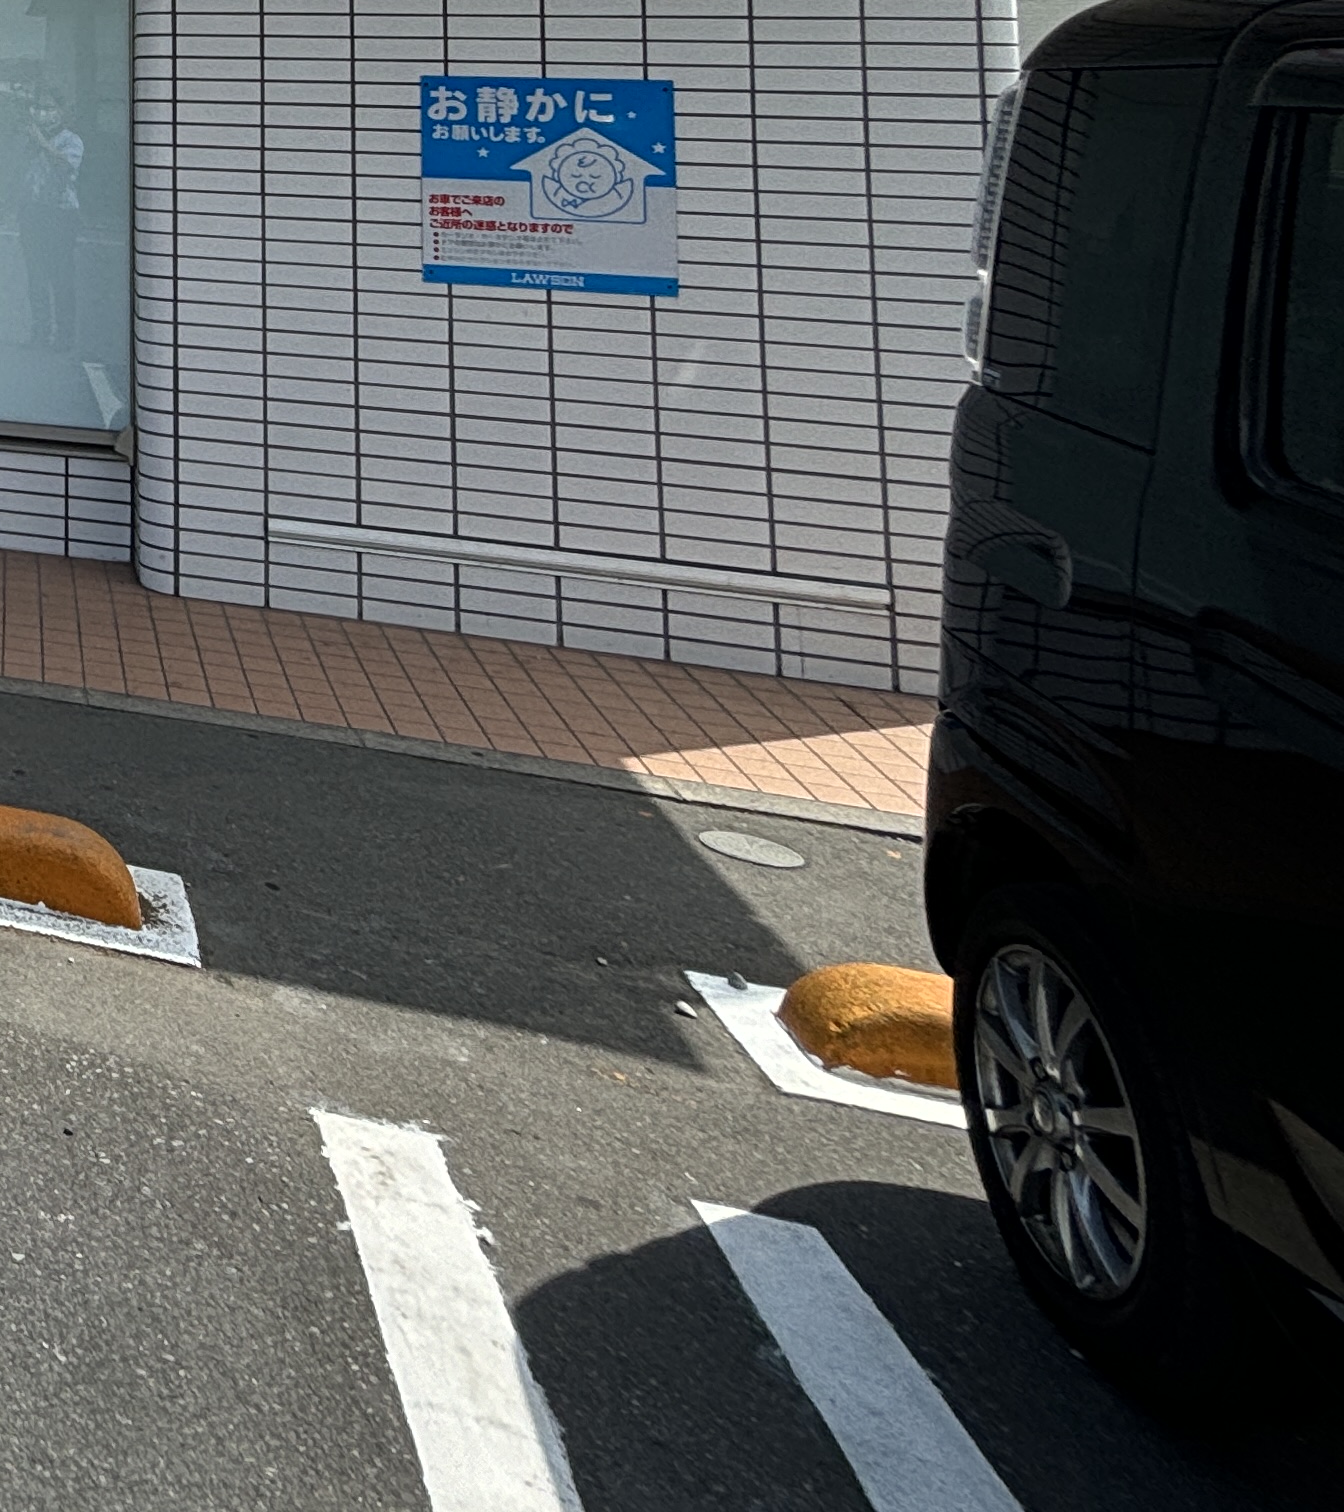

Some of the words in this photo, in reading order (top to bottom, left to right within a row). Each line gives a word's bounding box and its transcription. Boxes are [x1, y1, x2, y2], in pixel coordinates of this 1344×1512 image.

[427, 85, 615, 123] お静かに
[428, 194, 505, 206] お車でご来店の
[428, 206, 473, 217] お客様へ
[429, 219, 574, 234] ご近所の迷惑となりますので
[511, 272, 585, 288] LAWSON
